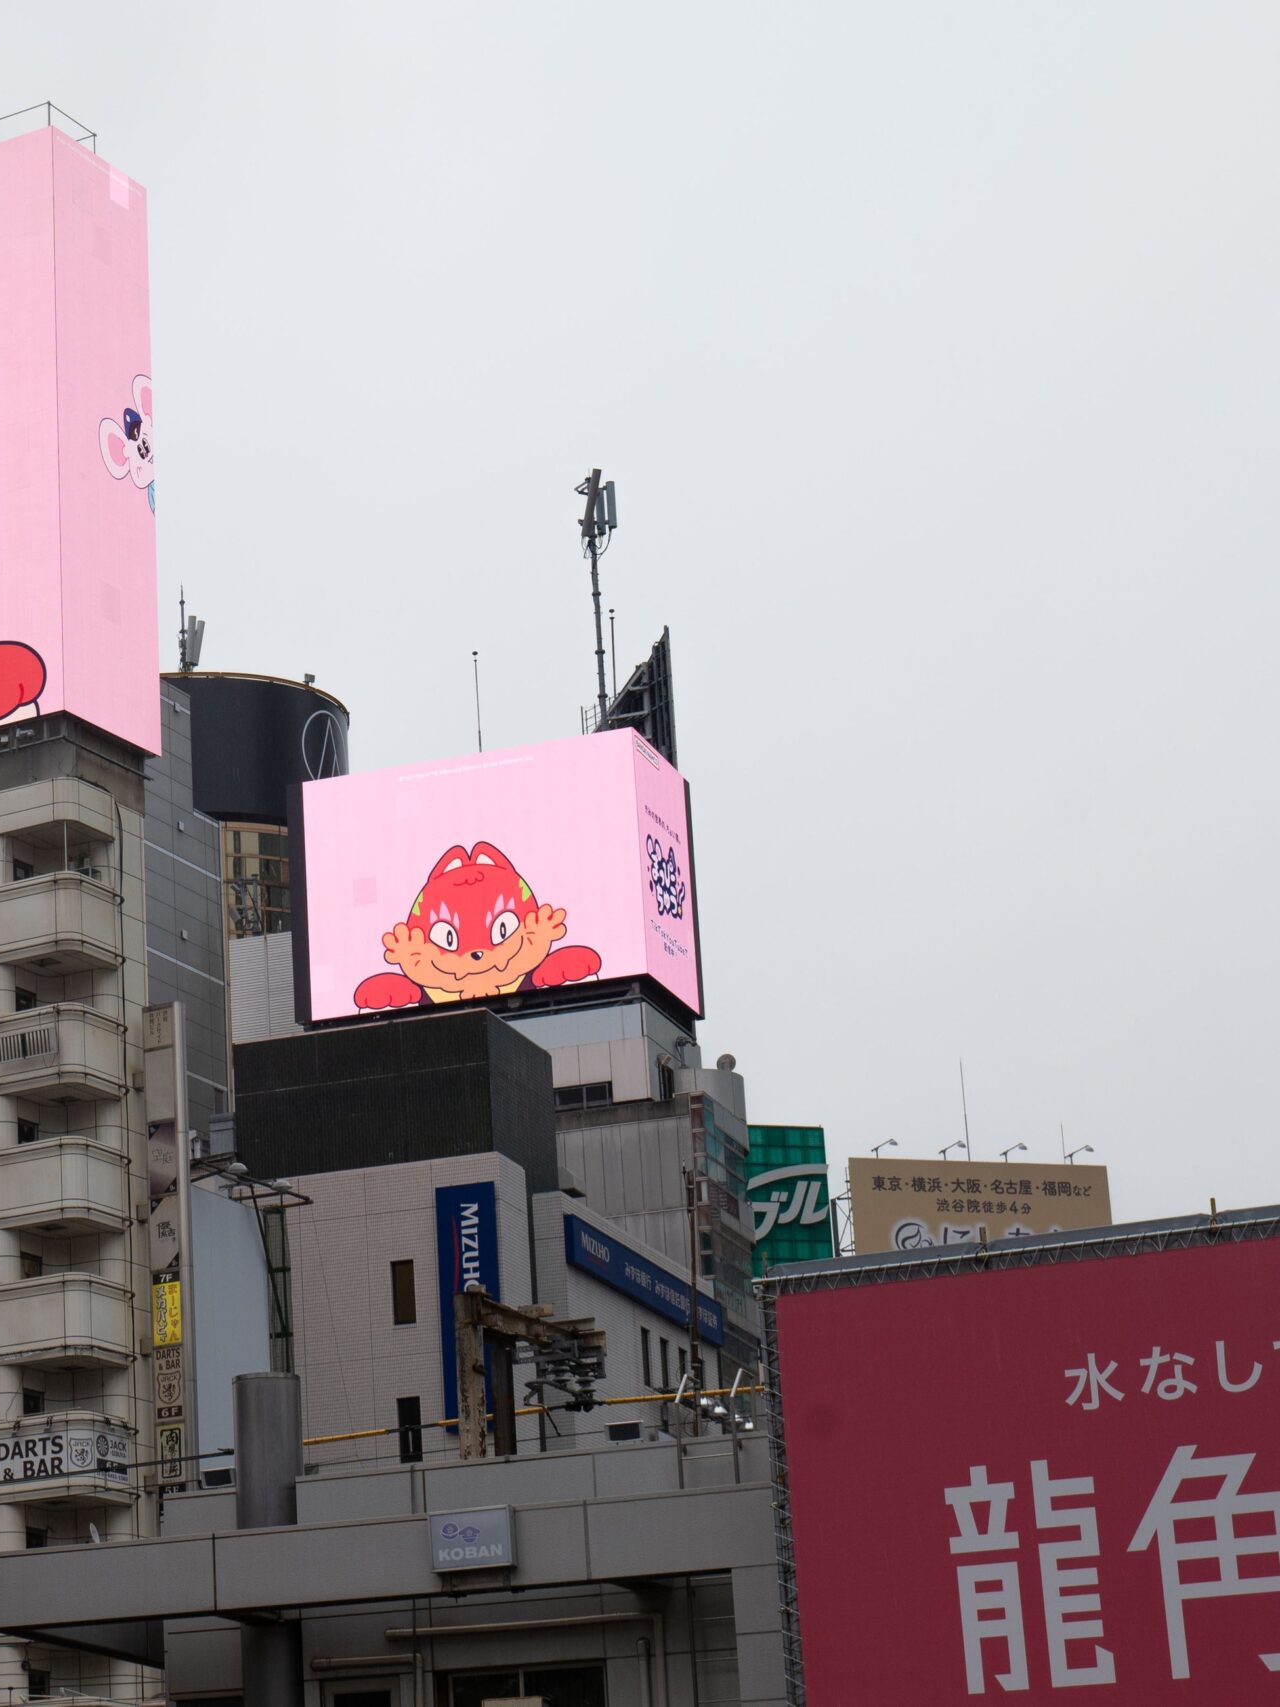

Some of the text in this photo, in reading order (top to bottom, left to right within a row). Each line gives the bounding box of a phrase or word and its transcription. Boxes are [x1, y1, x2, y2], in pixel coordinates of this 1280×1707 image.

[871, 1175, 1092, 1197] 東京・横浜・大阪・名古屋・福岡など
[580, 1231, 610, 1263] MIZUHO
[160, 1273, 172, 1283] 7F
[156, 1348, 181, 1361] DARTS
[165, 1359, 181, 1370] BAR
[1064, 1340, 1280, 1411] 水なし
[110, 1440, 127, 1453] JACK
[3, 1456, 65, 1481] & BAR
[438, 1544, 503, 1562] KOBAN
